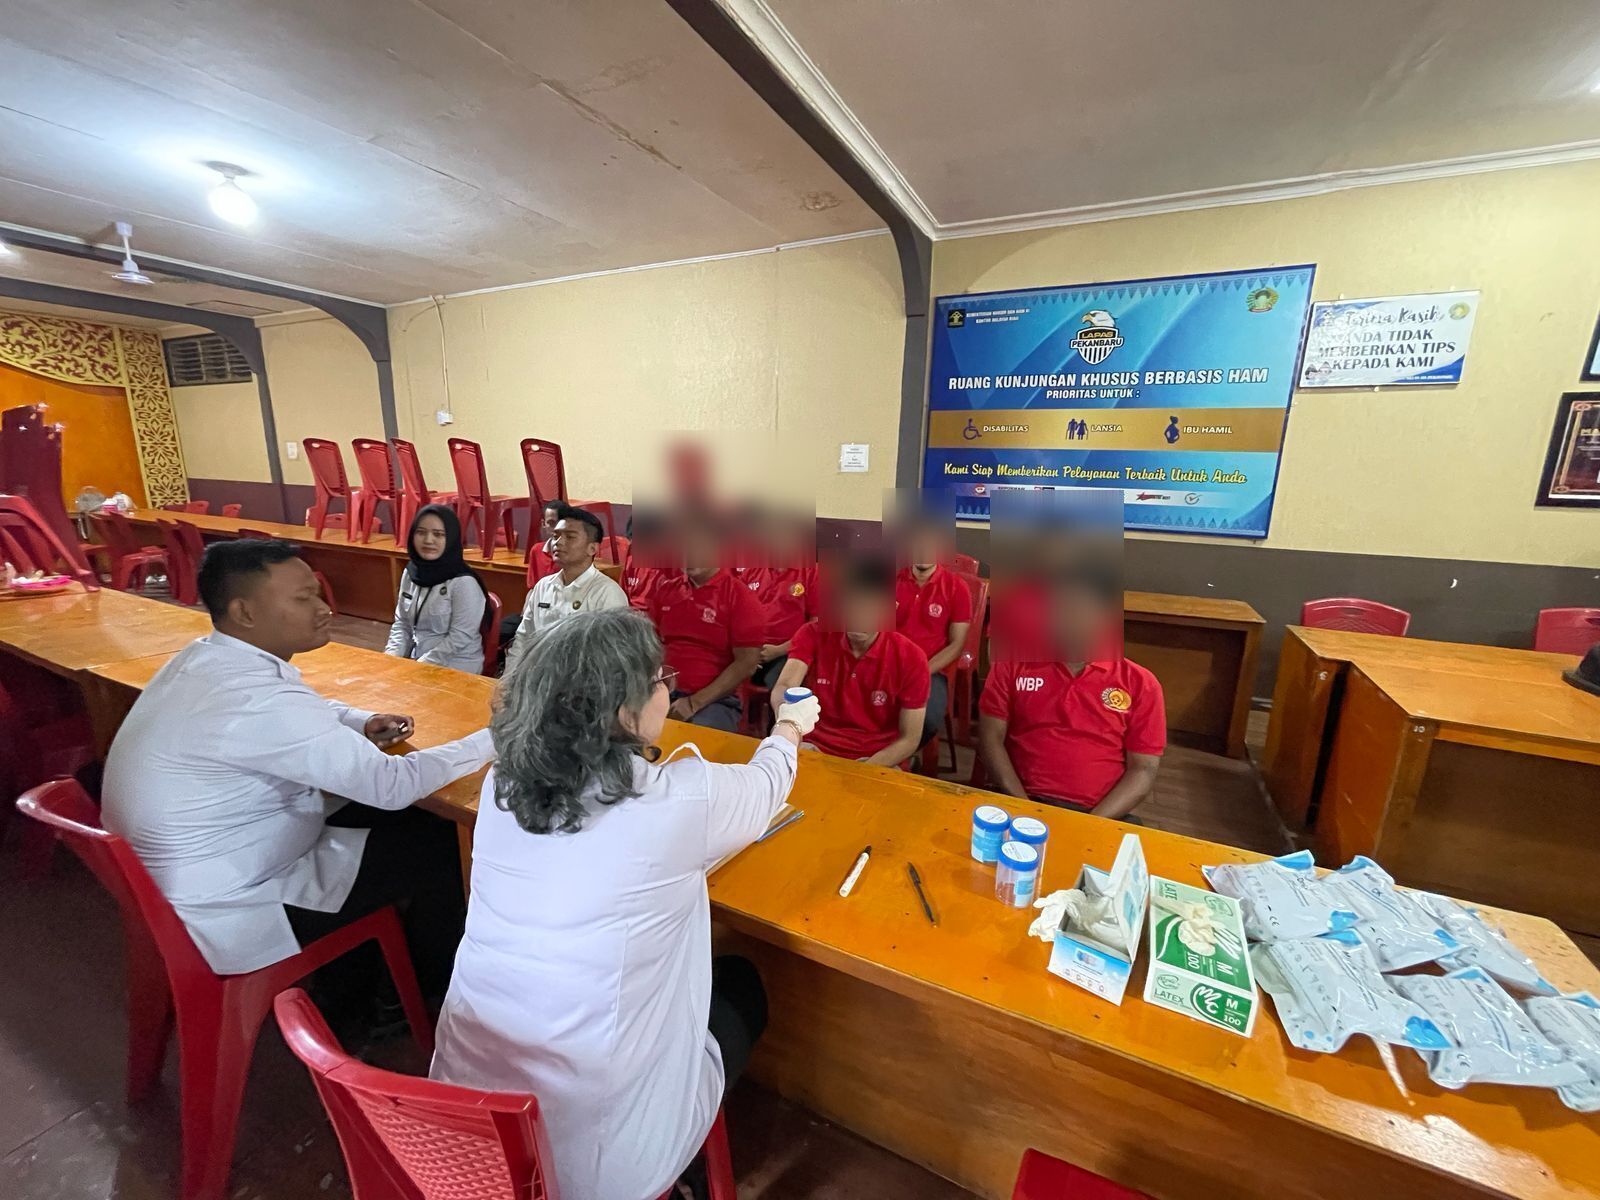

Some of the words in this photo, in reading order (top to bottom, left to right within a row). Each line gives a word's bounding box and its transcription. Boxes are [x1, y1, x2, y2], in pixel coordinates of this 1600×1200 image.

[1399, 305, 1441, 323] Kasih
[1082, 331, 1114, 339] LAPAS
[1389, 329, 1433, 341] TIDAK
[1072, 339, 1122, 348] PEKANBARU
[1319, 343, 1416, 358] MEMBERIKAN
[1423, 342, 1456, 354] TIPS
[1332, 358, 1391, 370] KEPADA
[1396, 356, 1435, 368] KAMI
[949, 376, 991, 390] RUANG
[995, 374, 1076, 388] KUNJUNGAN
[1081, 371, 1140, 386] KHUSUS
[1144, 369, 1223, 385] BERBASIS
[1228, 368, 1269, 383] HAM
[1046, 388, 1097, 399] PRIORITAS
[1100, 388, 1133, 399] UNTUK
[983, 424, 1029, 433] DISABILITAS
[1091, 424, 1123, 433] LANSIA
[1183, 426, 1199, 434] IBU
[1201, 426, 1233, 434] HAMIL
[944, 463, 969, 475] Kami
[972, 463, 993, 478] Siap
[997, 463, 1059, 477] Memberikan
[1063, 465, 1120, 481] Pelayanan
[1125, 467, 1167, 481] Terbaik
[1170, 468, 1208, 483] Untuk
[1211, 469, 1248, 484] Anda
[1015, 676, 1044, 691] WBP
[1164, 883, 1178, 900] LATE
[1187, 952, 1200, 969] 100
[1154, 989, 1185, 1005] LATEX
[1226, 997, 1239, 1010] M
[1223, 1014, 1242, 1026] 100
